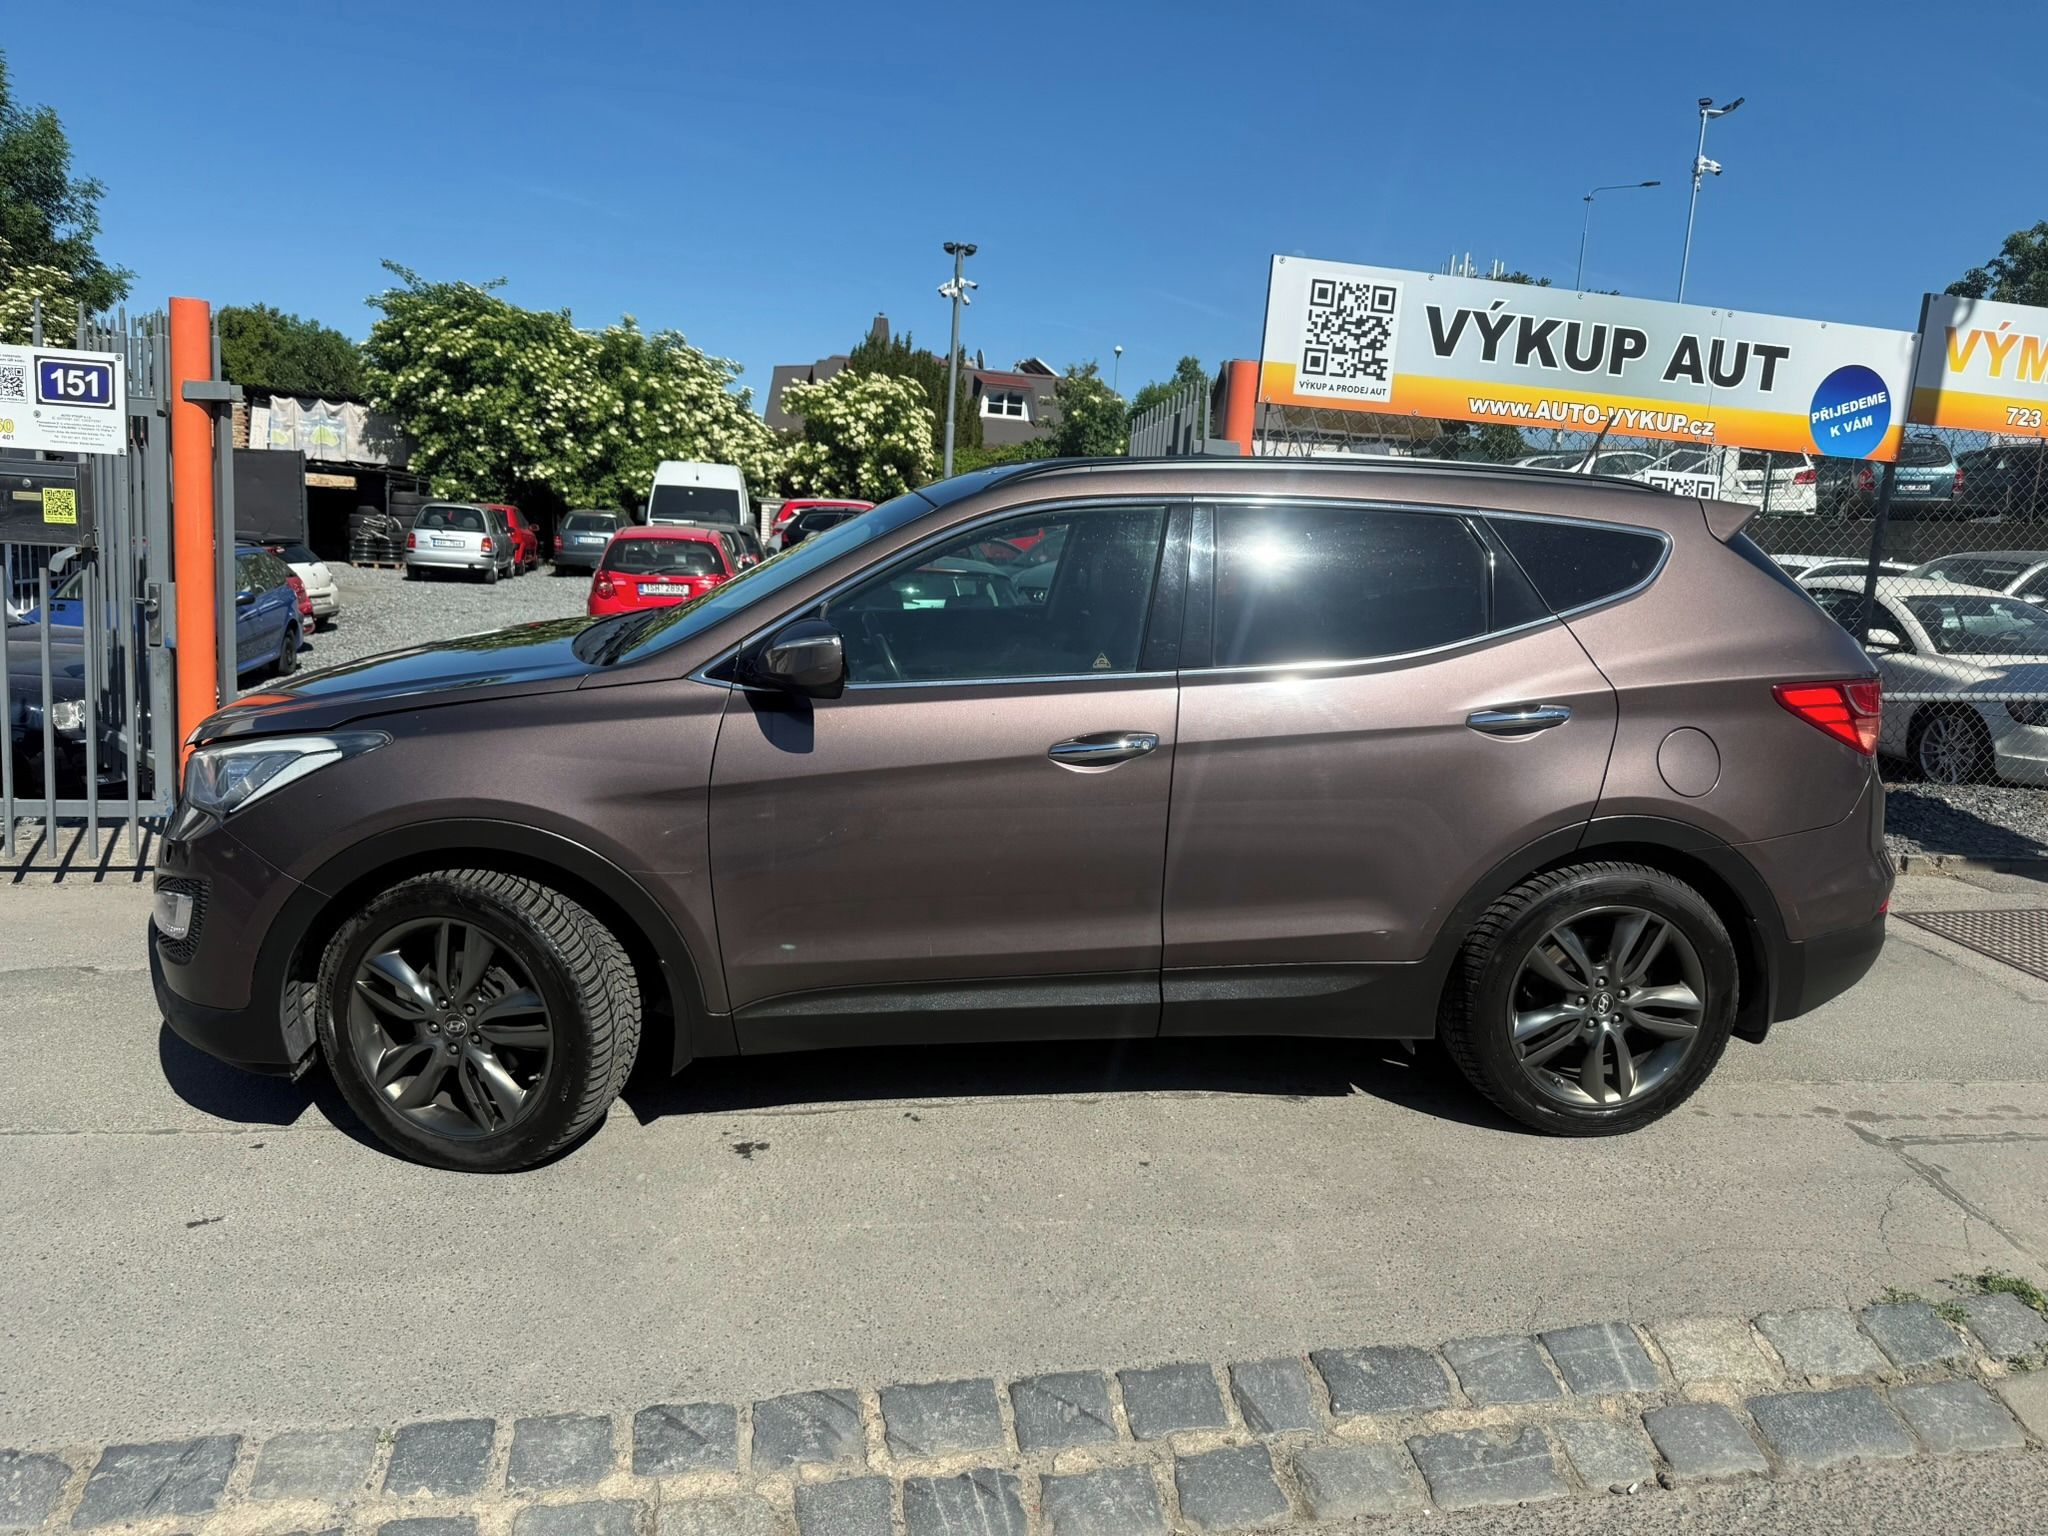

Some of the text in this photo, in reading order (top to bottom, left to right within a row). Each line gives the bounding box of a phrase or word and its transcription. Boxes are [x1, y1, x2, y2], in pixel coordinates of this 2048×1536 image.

[1425, 301, 1792, 394] VÝKUP AUT
[50, 368, 99, 398] 151
[1299, 380, 1387, 396] VÝKUP A PRODEJ AUT
[1468, 398, 1715, 436] www.AUTO-VYKUP.cz
[1811, 391, 1887, 424] PŘIJEDEME
[2006, 406, 2042, 428] 723
[1830, 415, 1873, 438] K VÁM
